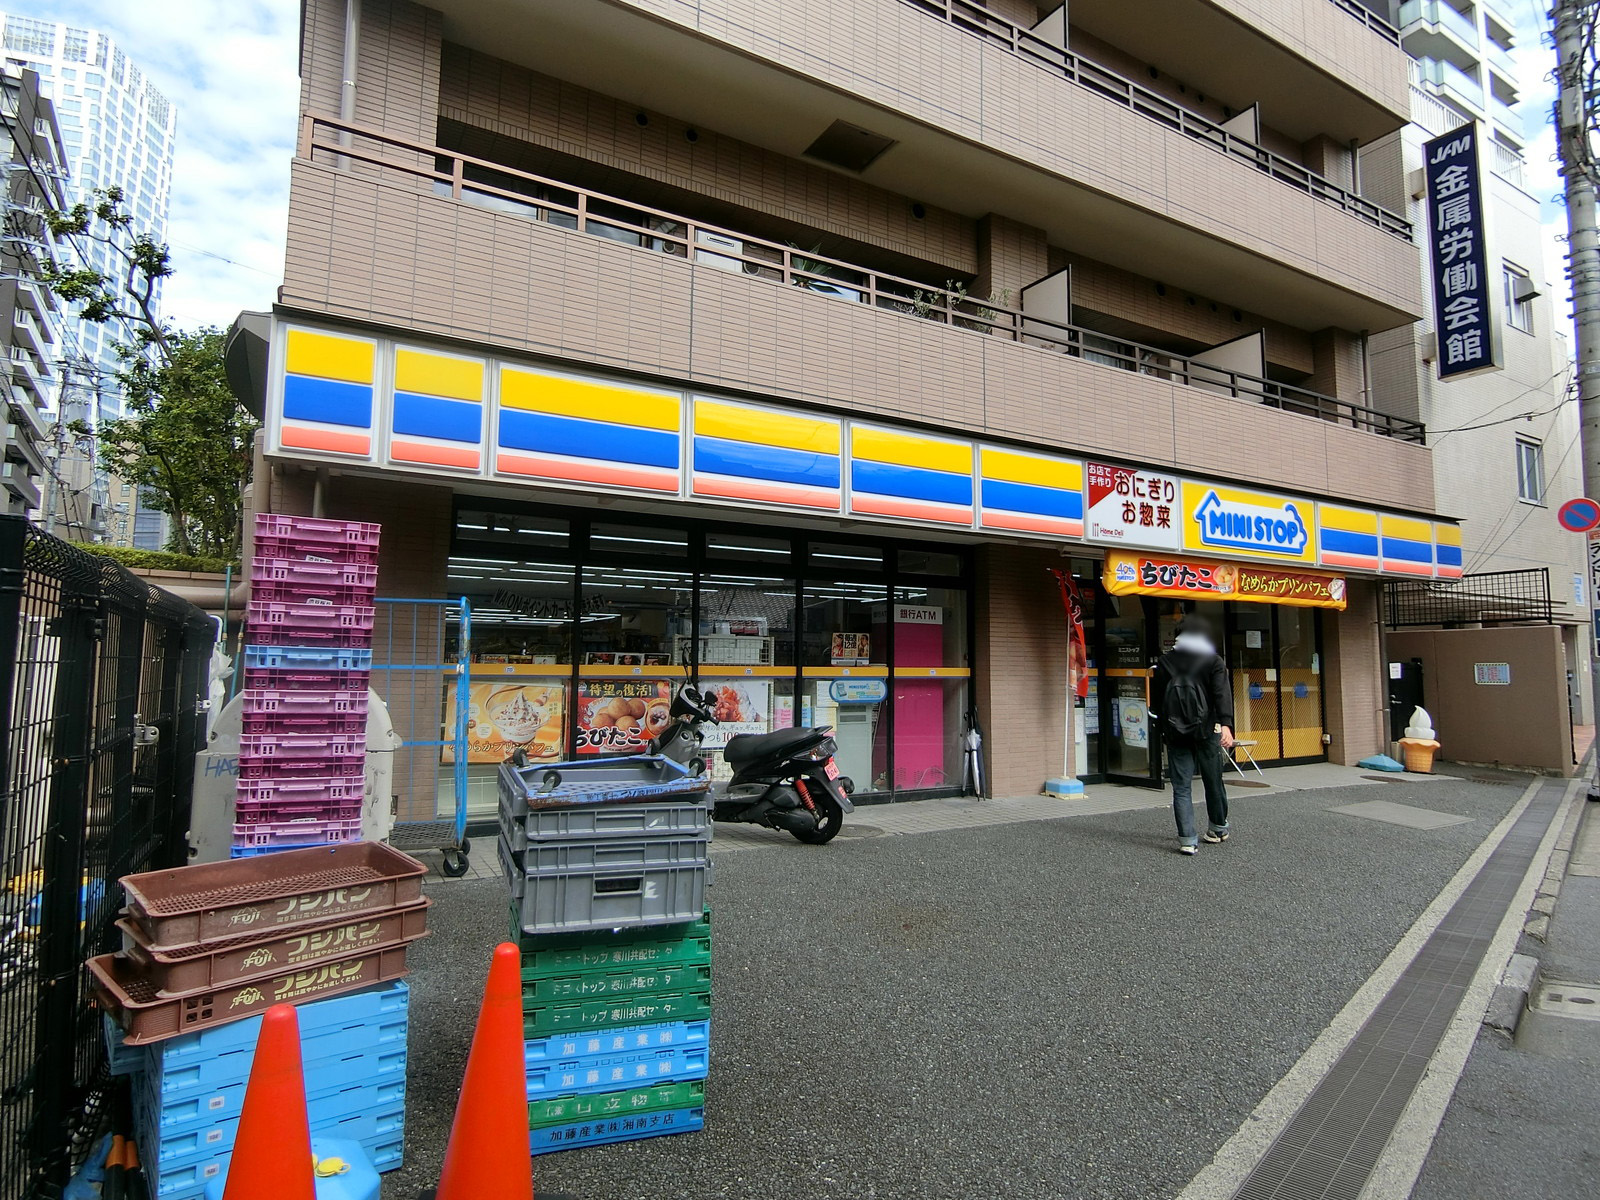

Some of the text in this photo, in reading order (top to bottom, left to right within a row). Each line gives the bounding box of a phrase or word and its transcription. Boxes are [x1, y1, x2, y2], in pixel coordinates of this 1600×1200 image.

[1430, 134, 1471, 165] JAM
[1435, 164, 1482, 366] 金属労働会館
[1088, 465, 1111, 477] お店で
[1088, 475, 1112, 488] 手作り
[1113, 471, 1175, 503] おにぎり
[1121, 500, 1171, 529] お惣菜
[1209, 510, 1299, 545] MINISTOP
[1140, 562, 1213, 589] ちびたこ
[1241, 573, 1330, 597] なめらかプリンパフェ
[899, 608, 937, 621] 銀行ATM
[274, 887, 371, 916] フジパン
[286, 922, 380, 957] フジパン
[272, 960, 364, 995] フジパン
